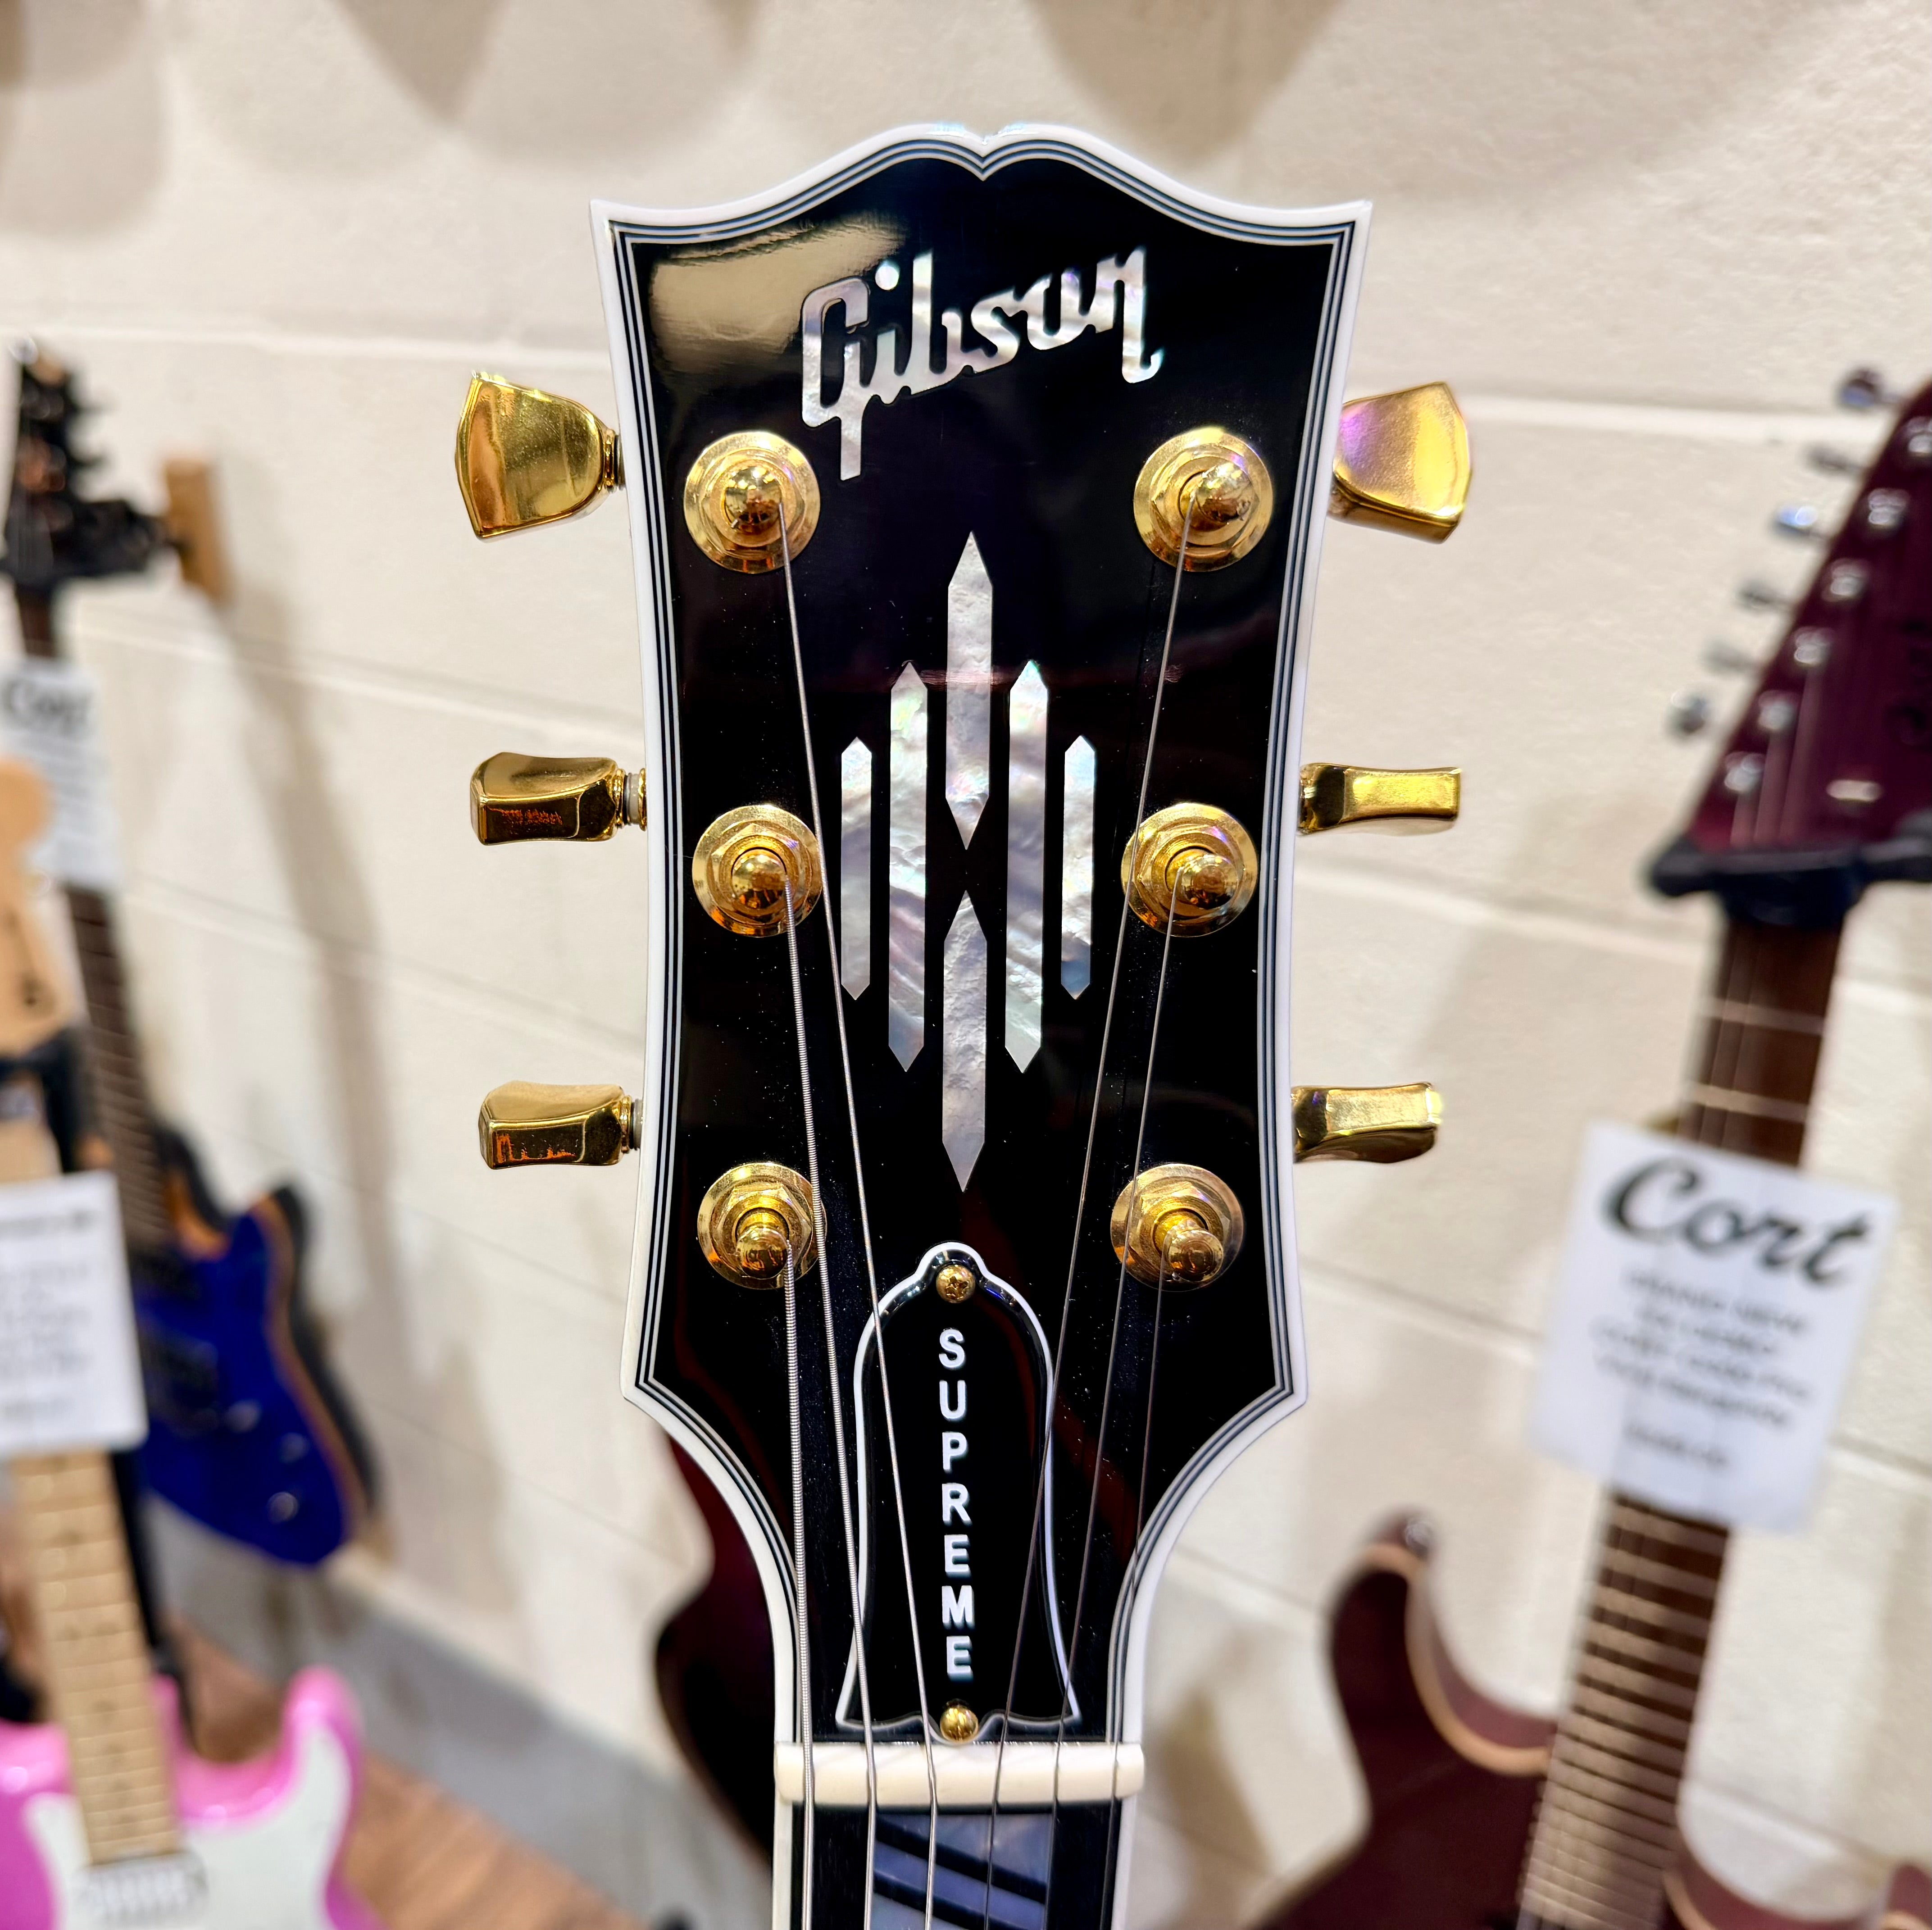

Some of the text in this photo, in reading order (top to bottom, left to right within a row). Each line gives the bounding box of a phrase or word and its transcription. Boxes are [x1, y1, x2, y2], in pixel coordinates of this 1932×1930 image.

[801, 247, 1164, 481] Gibson
[1602, 1154, 1872, 1287] Cort
[938, 1328, 975, 1680] SUPREME
